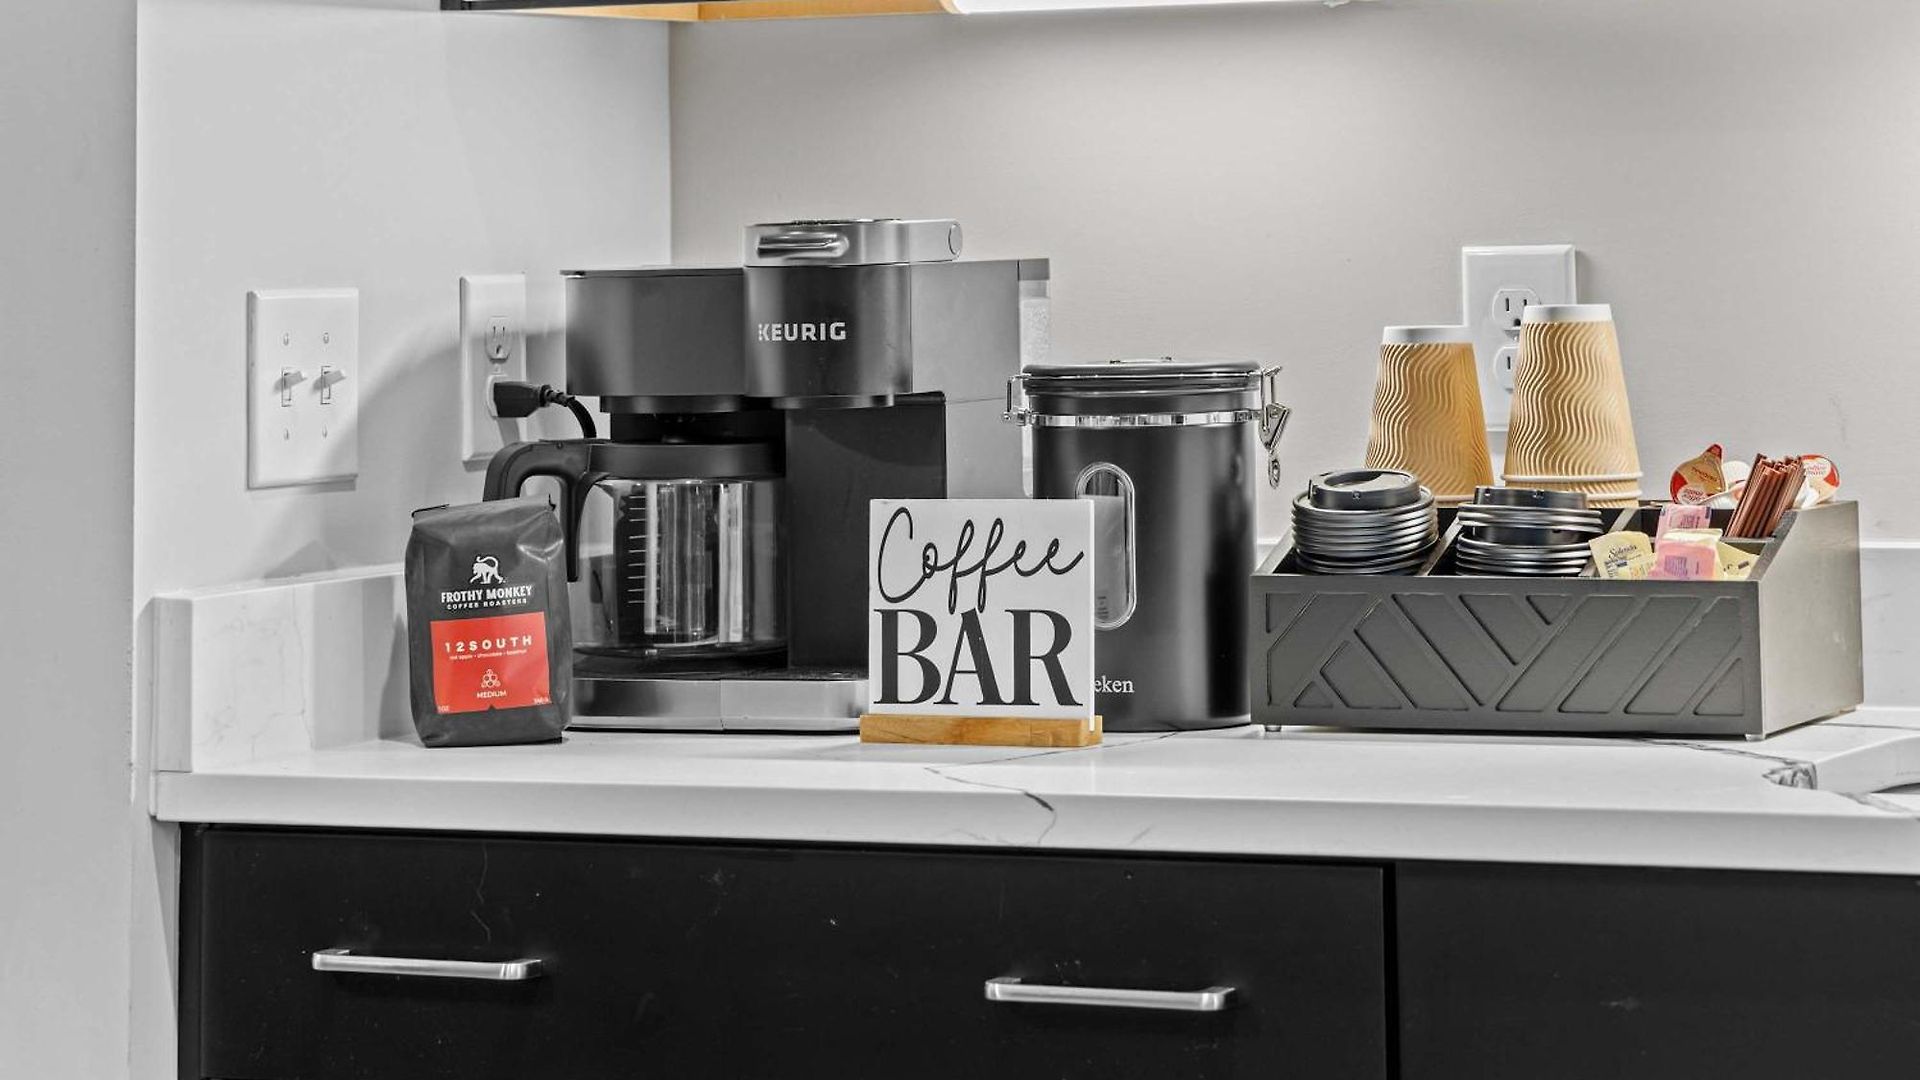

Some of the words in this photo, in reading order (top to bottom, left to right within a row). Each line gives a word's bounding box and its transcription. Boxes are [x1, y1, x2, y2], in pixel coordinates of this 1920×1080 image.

[758, 322, 846, 341] KEURIG
[878, 506, 1085, 615] Coffee
[441, 590, 482, 603] FROTHY
[486, 585, 532, 600] MONKEY
[873, 607, 1083, 706] BAR
[1094, 675, 1135, 693] eken
[477, 690, 507, 699] MEDIUM
